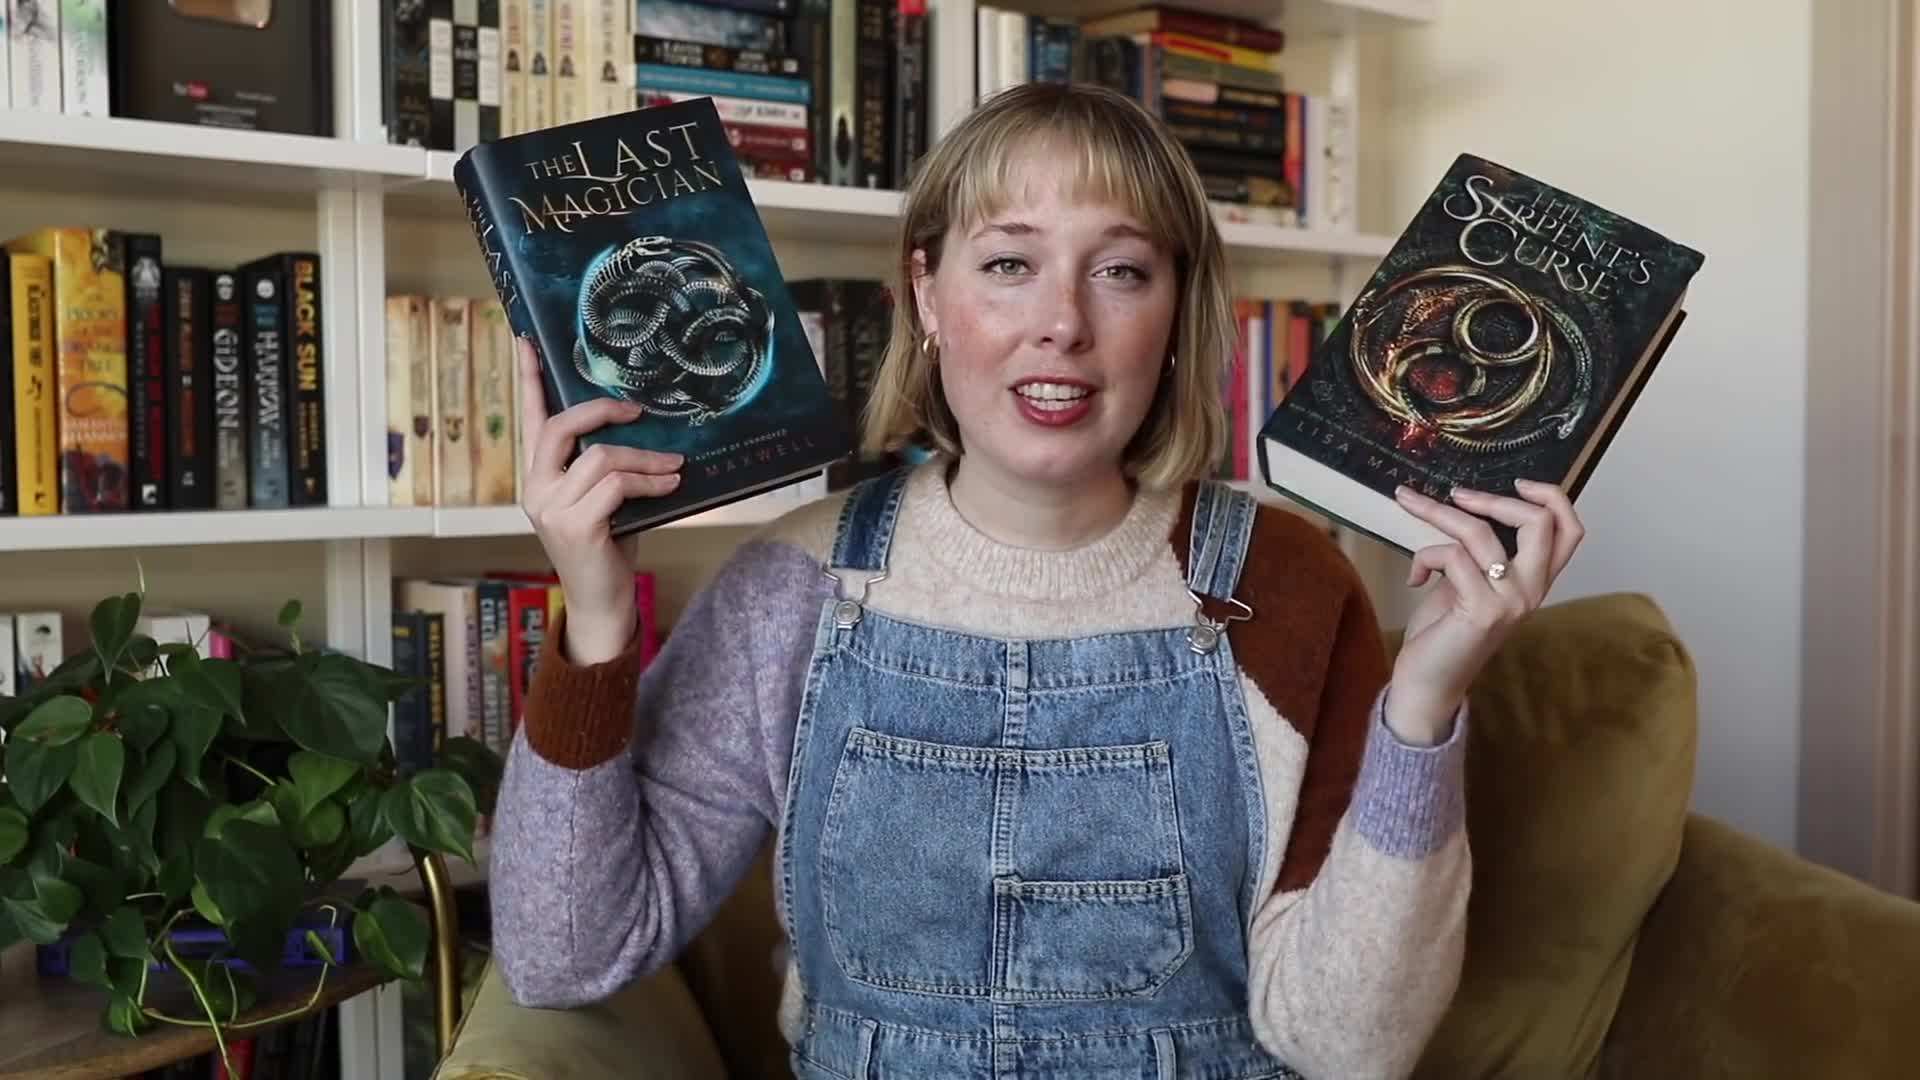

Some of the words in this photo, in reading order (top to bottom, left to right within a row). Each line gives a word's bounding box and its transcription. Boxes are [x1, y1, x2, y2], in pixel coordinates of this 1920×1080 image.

[525, 154, 577, 180] THE
[560, 121, 701, 183] LAST
[508, 160, 724, 235] MAGICIAN
[1443, 174, 1656, 285] SERPENT'S
[482, 223, 521, 305] LAST
[1459, 218, 1618, 301] CURSE
[294, 259, 315, 337] BLACK
[298, 343, 318, 391] SUN
[695, 445, 728, 462] AUTHOR
[703, 437, 815, 476] MAXWELL
[1296, 421, 1349, 453] LISA
